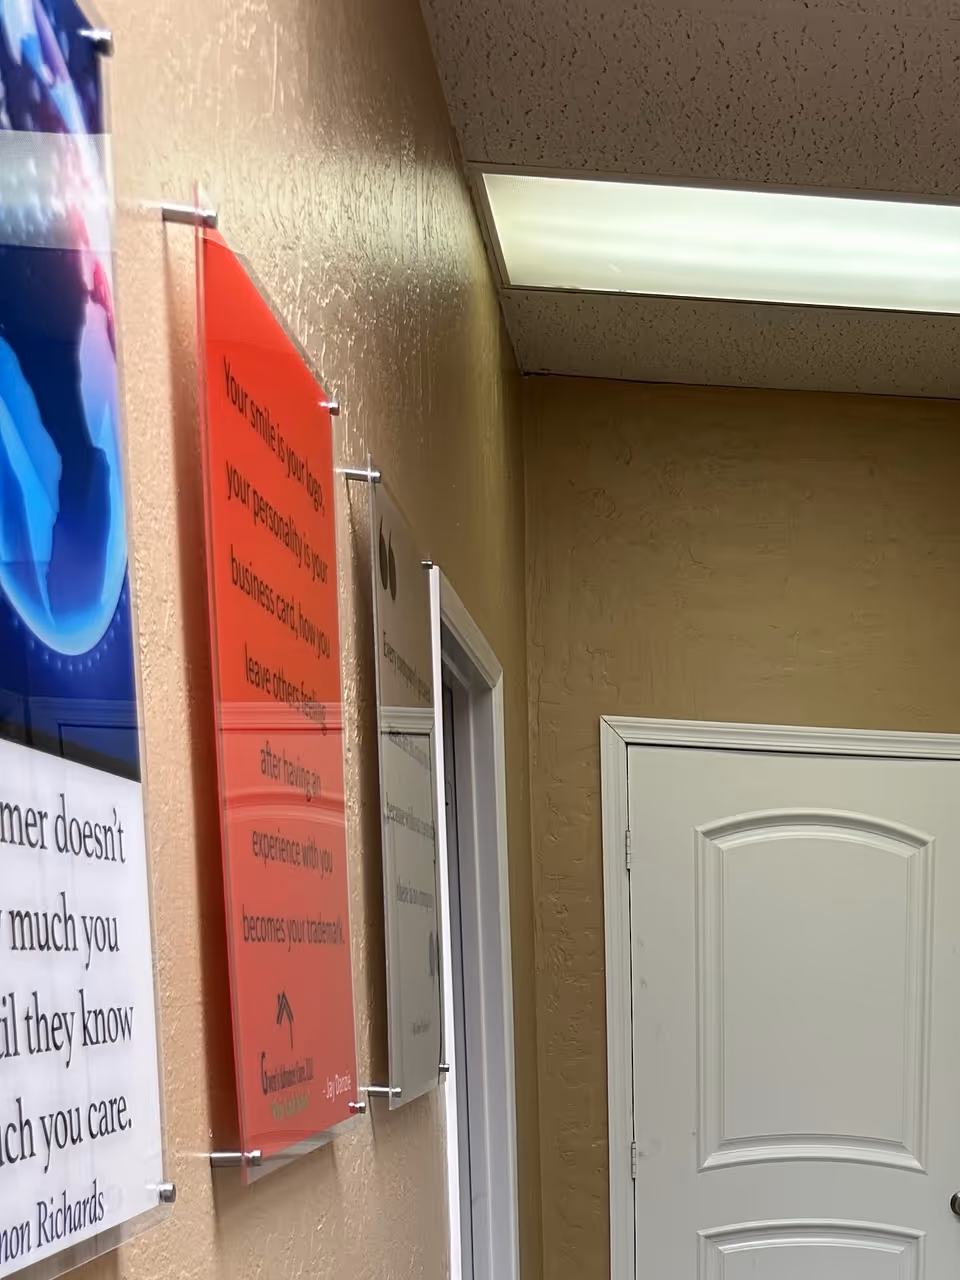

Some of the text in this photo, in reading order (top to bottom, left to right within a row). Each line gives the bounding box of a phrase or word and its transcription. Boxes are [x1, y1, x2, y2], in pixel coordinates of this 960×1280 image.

[223, 354, 248, 418] Your
[250, 399, 276, 452] smile
[277, 423, 285, 463] is
[286, 443, 305, 486] your
[225, 459, 328, 585] your personality is your
[230, 543, 330, 660] business card, how you
[244, 641, 271, 695] leave
[272, 666, 300, 712] others
[260, 739, 321, 802] after having an
[54, 793, 126, 864] doesn't
[252, 827, 333, 880] experience with you
[9, 891, 120, 971] much you
[242, 903, 285, 943] becomes
[286, 918, 305, 953] your
[0, 988, 134, 1069] il they know
[0, 1095, 132, 1174] ch you care.
[36, 1178, 104, 1249] Richards
